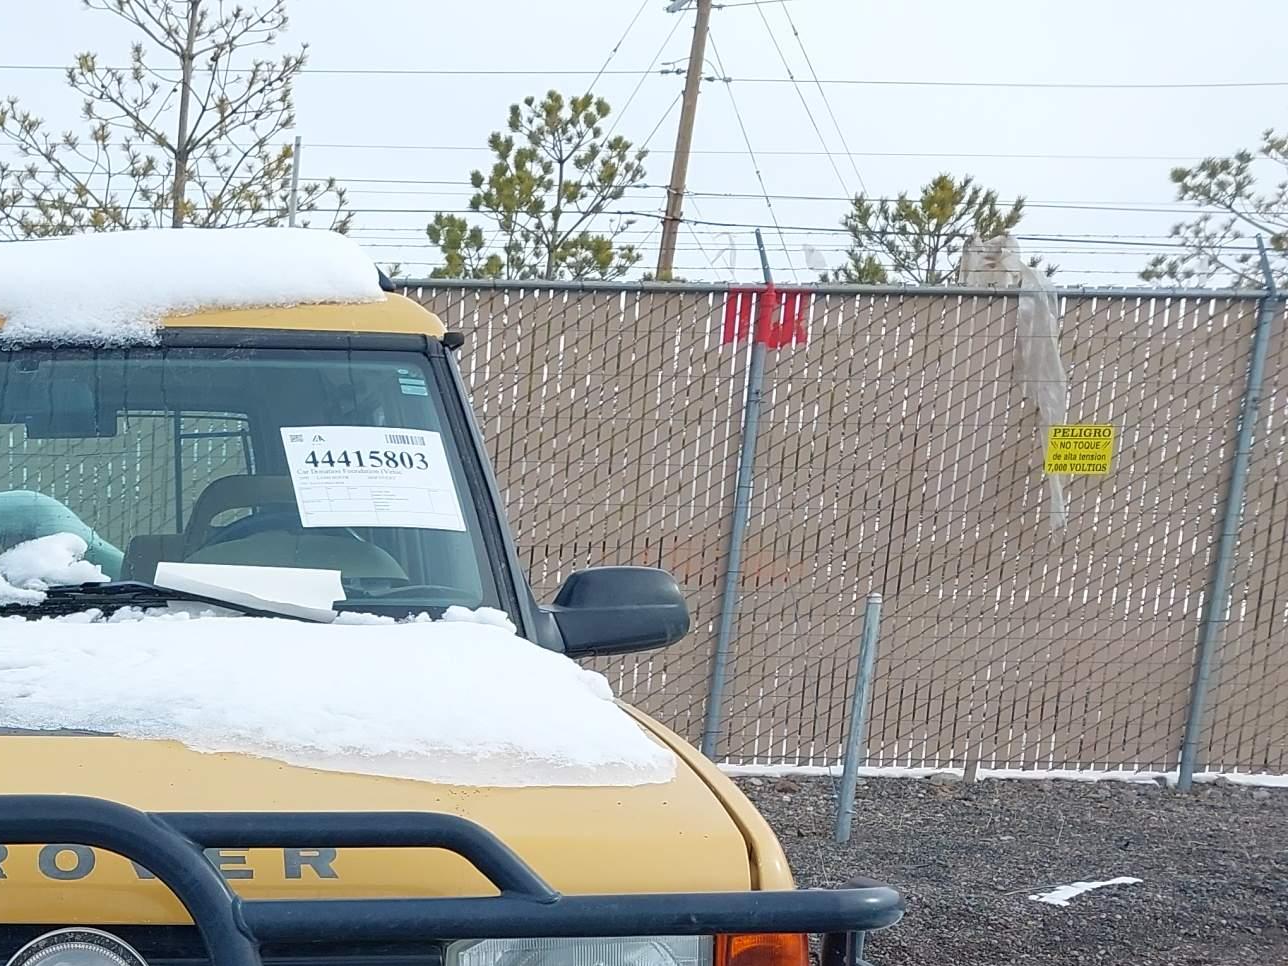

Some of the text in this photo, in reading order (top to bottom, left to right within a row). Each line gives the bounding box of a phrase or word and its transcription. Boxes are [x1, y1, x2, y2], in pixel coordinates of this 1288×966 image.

[1053, 428, 1112, 438] PELIGRO
[1059, 441, 1101, 449] NO TOQUE
[304, 450, 429, 470] 44415803
[1052, 453, 1106, 461] de alta tension
[1047, 463, 1107, 472] 7,000 VOLTIOS
